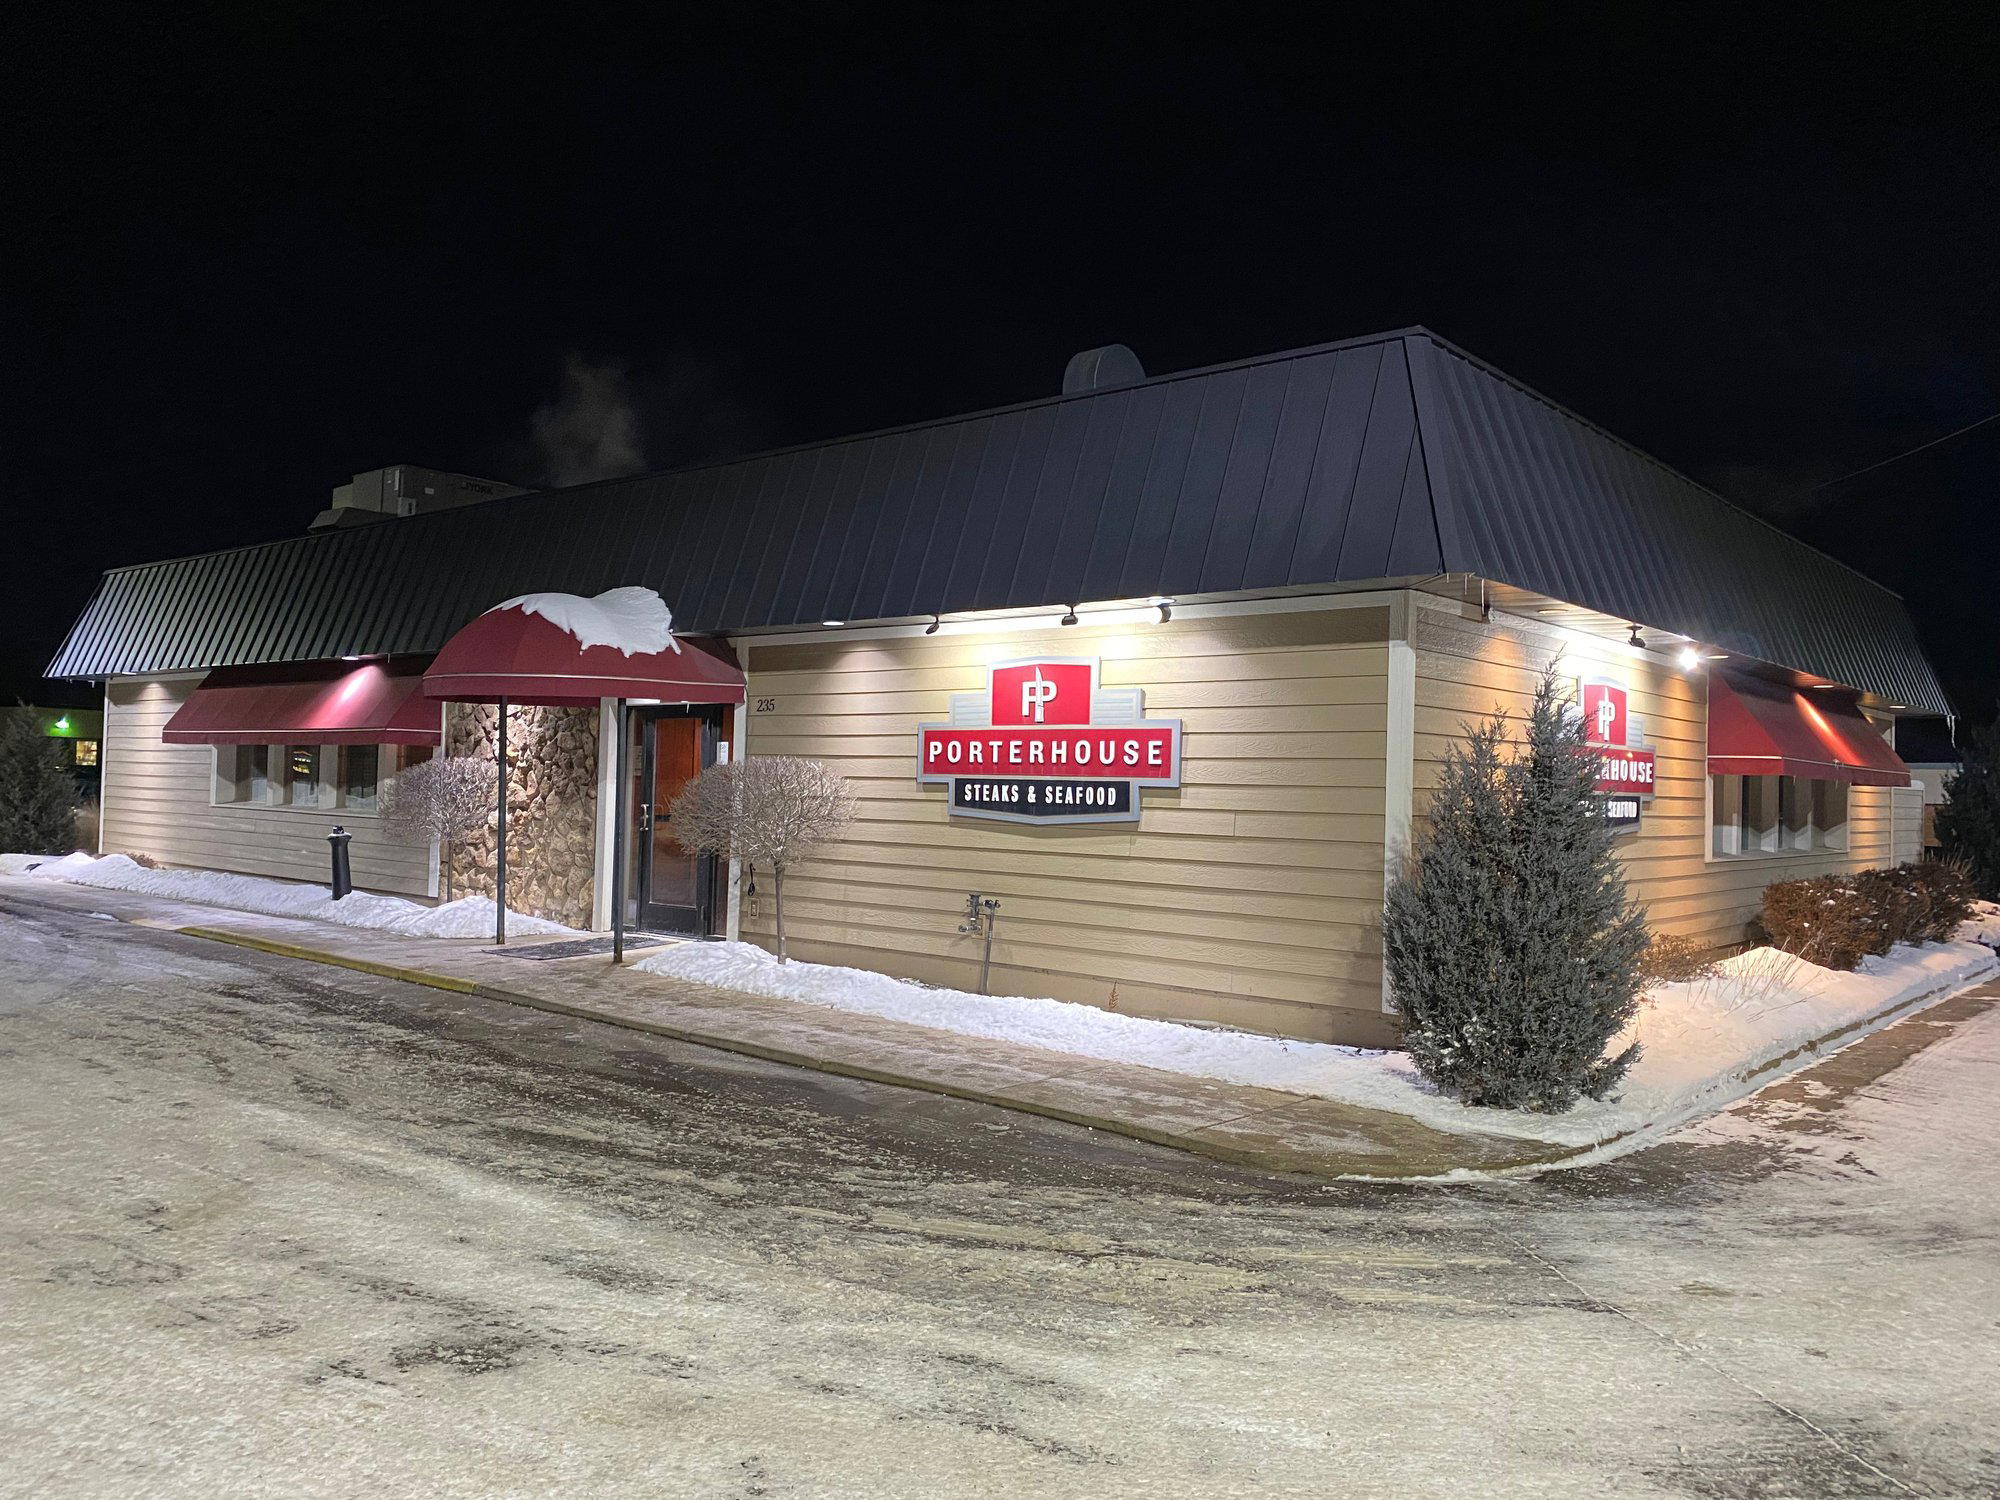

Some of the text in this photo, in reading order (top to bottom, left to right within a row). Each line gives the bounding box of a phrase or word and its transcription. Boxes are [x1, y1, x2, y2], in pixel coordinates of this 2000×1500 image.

[756, 699, 775, 713] 235
[929, 740, 1163, 765] PORTERHOUSE
[964, 783, 1117, 806] STEAKS & SEAFOOD
